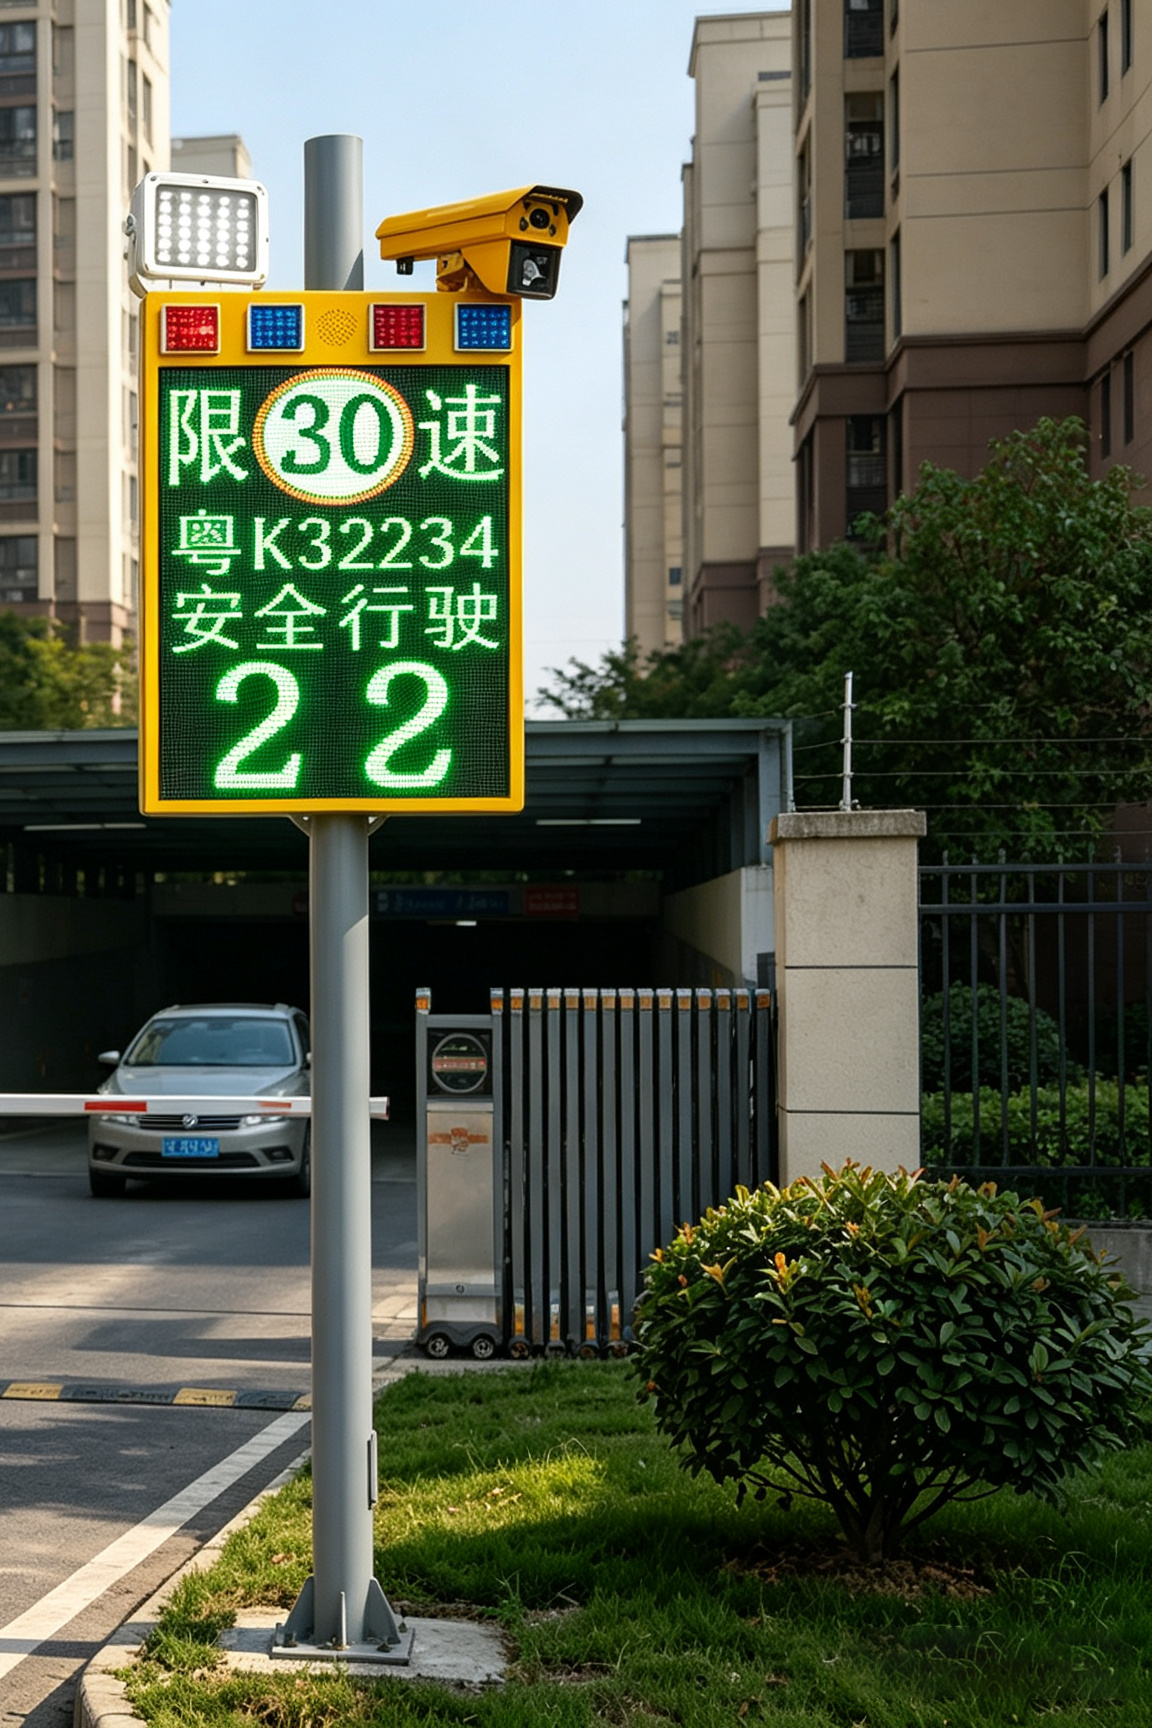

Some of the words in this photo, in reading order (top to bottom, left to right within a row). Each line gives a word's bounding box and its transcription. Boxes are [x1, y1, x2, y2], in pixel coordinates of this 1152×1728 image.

[168, 388, 249, 486] 限
[279, 392, 396, 475] 30
[418, 383, 505, 481] 速
[171, 583, 500, 653] 安全行驶
